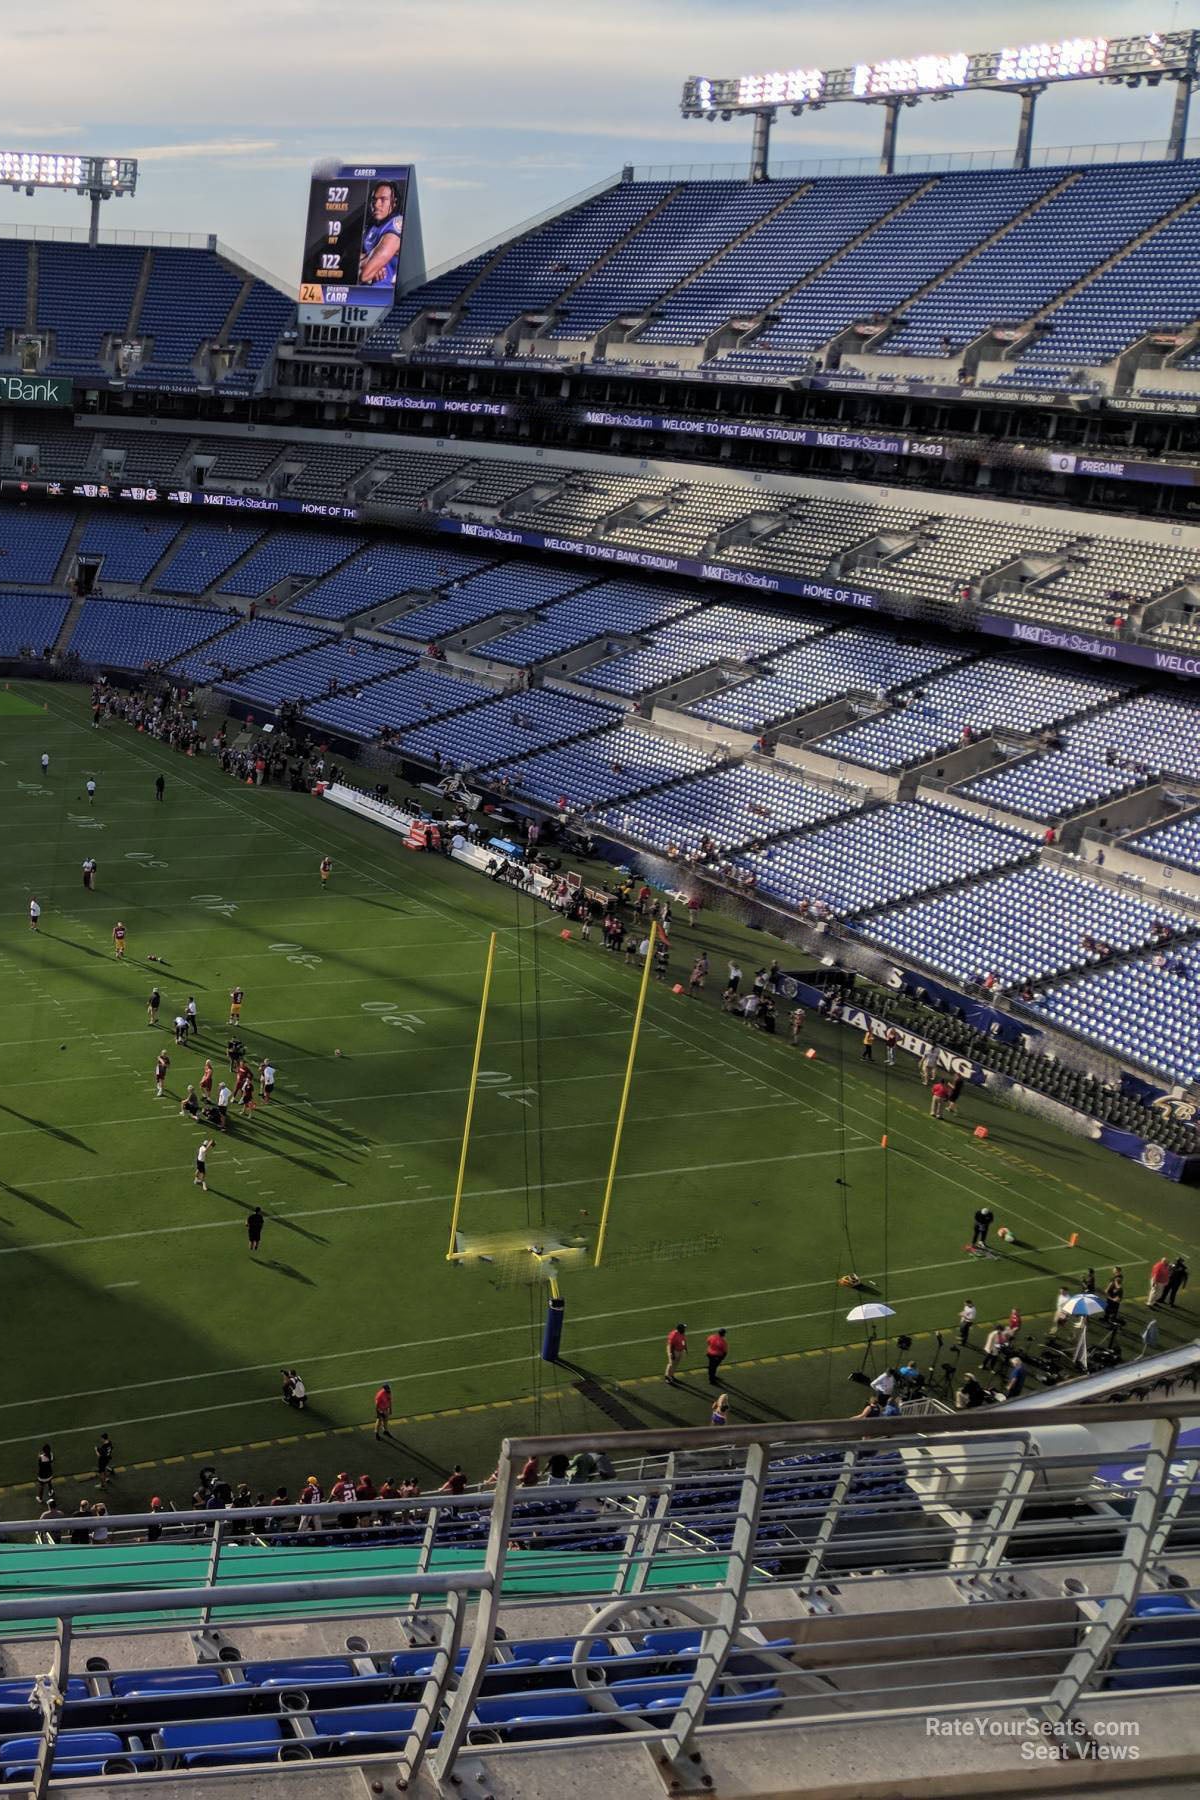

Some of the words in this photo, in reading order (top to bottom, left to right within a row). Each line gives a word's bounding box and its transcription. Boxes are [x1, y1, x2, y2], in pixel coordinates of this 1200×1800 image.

[354, 169, 377, 177] CAREER
[327, 187, 349, 201] 527
[328, 221, 341, 235] 19
[322, 254, 341, 268] 122
[302, 286, 315, 301] 24
[326, 292, 347, 303] CARR
[341, 306, 369, 324] Lite
[8, 378, 59, 401] Bank
[365, 395, 384, 406] M&T
[384, 396, 403, 408] Bank
[405, 397, 437, 409] Stadium
[444, 401, 468, 412] HOME
[470, 403, 482, 413] OF
[484, 404, 500, 415] THE
[586, 412, 605, 424] M&T
[605, 413, 623, 425] Bank
[623, 415, 653, 428] Stadium
[662, 419, 705, 433] WELCOME
[707, 423, 719, 433] TO
[719, 425, 739, 436] M&T
[740, 427, 764, 438] BANK
[766, 428, 807, 442] STADIUM
[816, 432, 840, 446] M&T
[840, 434, 862, 448] Bank
[862, 437, 898, 452] Stadium
[911, 442, 943, 456] 34:03
[1080, 460, 1124, 476] PREGAME
[203, 494, 225, 505] M&T
[225, 496, 244, 507] Bank
[246, 498, 278, 510] Stadium
[302, 504, 326, 515] HOME
[328, 506, 340, 516] OF
[461, 523, 477, 536] M&T
[478, 526, 495, 539] Bank
[495, 528, 522, 543] Stadium
[543, 538, 584, 555] WELCOME
[585, 544, 597, 556] TO
[597, 546, 615, 559] M&T
[616, 548, 639, 563] BANK
[641, 553, 678, 570] STADIUM
[702, 565, 724, 580] M&T
[724, 568, 744, 583] Bank
[744, 572, 778, 589] Stadium
[803, 584, 832, 600] HOME
[834, 589, 850, 601] OF
[852, 593, 872, 607] THE
[1012, 623, 1042, 642] M&T
[1042, 629, 1069, 646] Bank
[1070, 634, 1116, 657] Stadium
